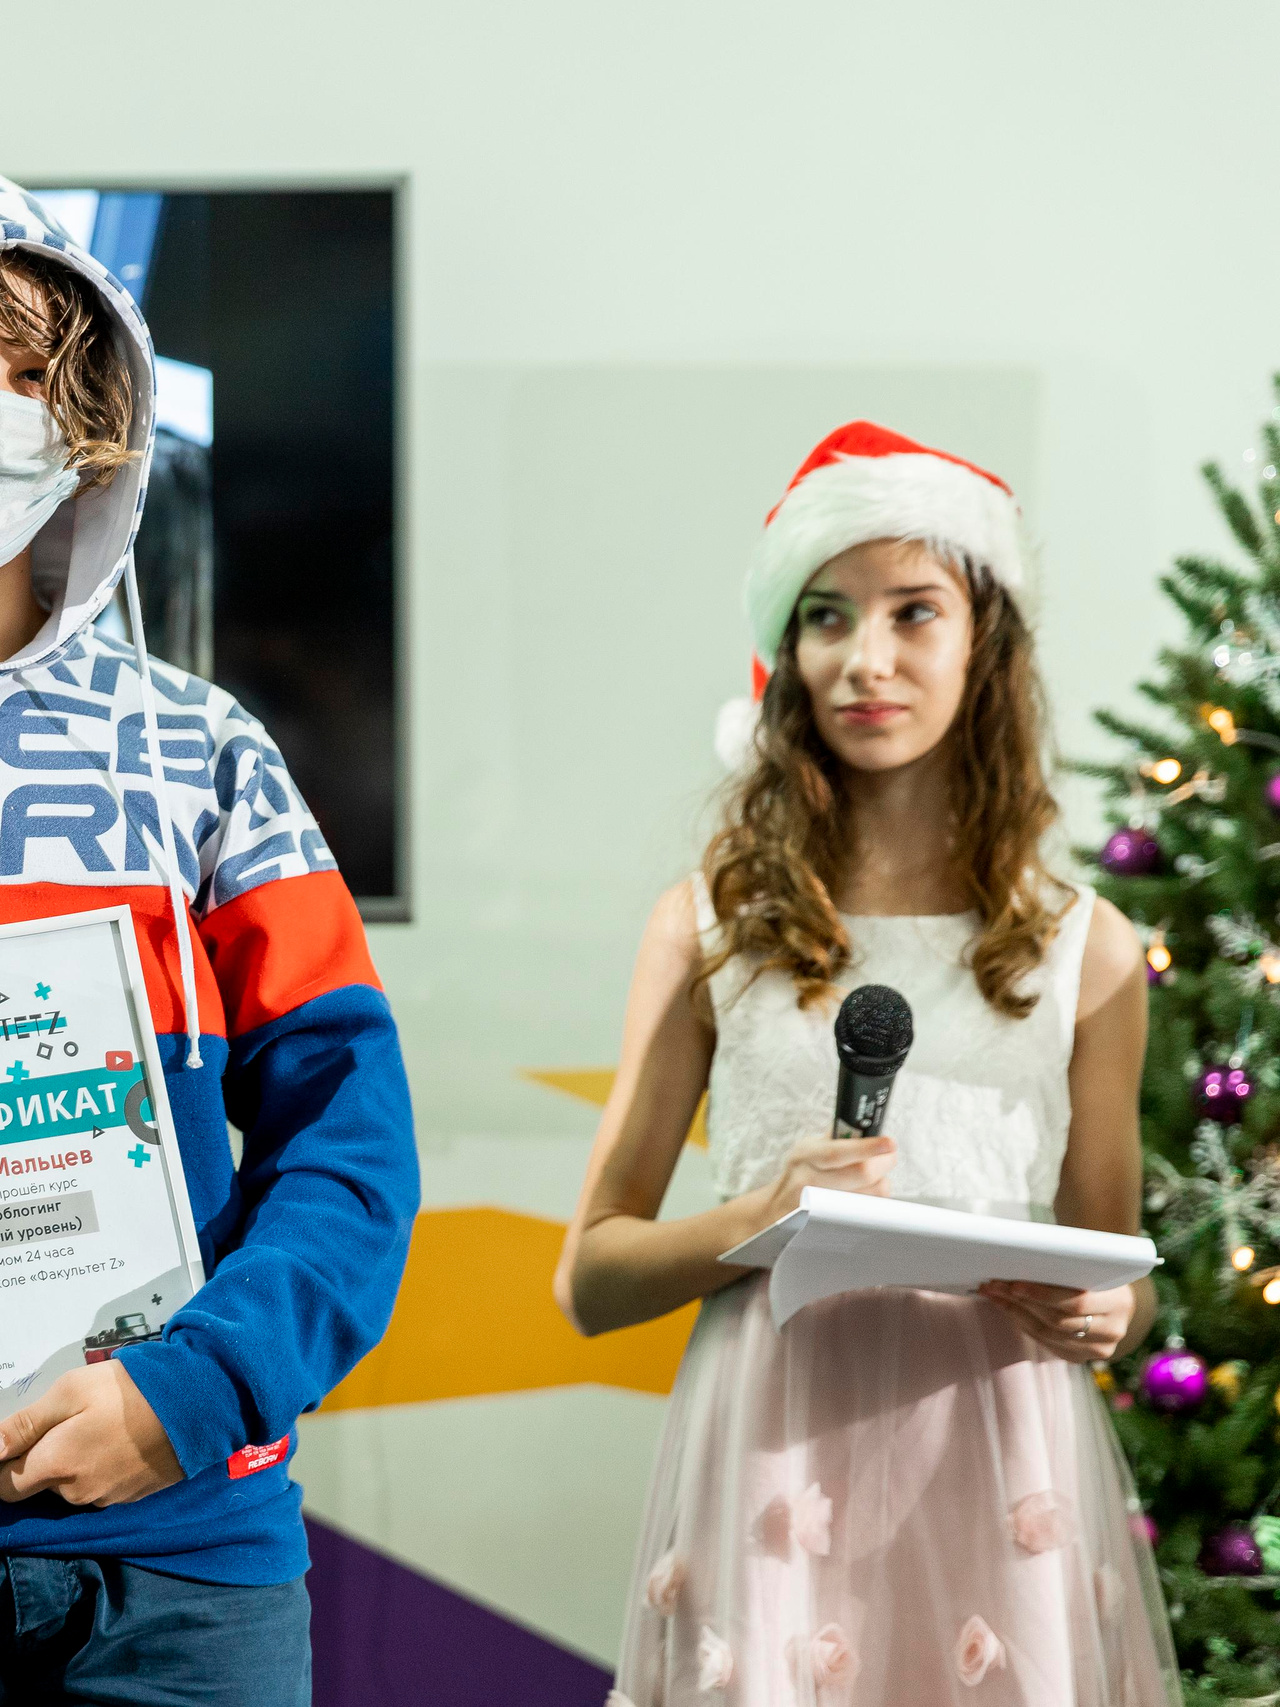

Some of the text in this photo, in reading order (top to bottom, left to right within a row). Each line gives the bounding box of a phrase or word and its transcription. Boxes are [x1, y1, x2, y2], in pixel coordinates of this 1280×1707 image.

[49, 1177, 78, 1194] курс
[17, 1216, 83, 1242] уровень)
[26, 1250, 41, 1263] 24
[44, 1245, 75, 1259] часа
[30, 1262, 107, 1282] «Факультет
[110, 1257, 125, 1270] Z»
